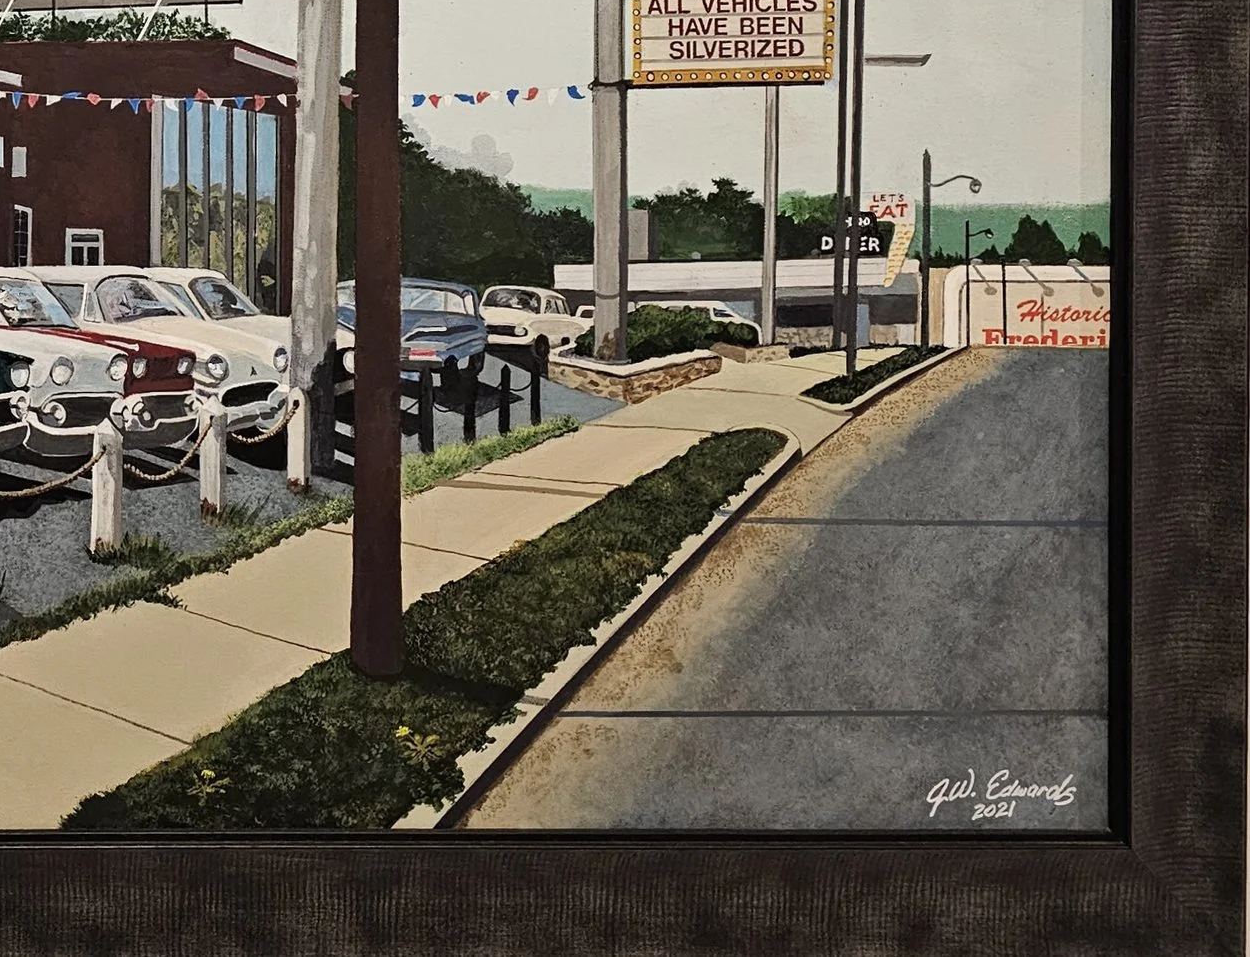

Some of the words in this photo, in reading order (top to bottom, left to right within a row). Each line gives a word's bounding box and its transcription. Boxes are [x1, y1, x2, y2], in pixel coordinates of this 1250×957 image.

[668, 17, 728, 36] HAVE
[740, 16, 803, 35] BEEN
[669, 39, 805, 59] SILVERIZED
[873, 192, 904, 202] LET'S
[868, 203, 908, 219] EAT
[1016, 299, 1110, 322] Historic
[986, 769, 1077, 805] Edwards
[972, 800, 1016, 820] 2021
